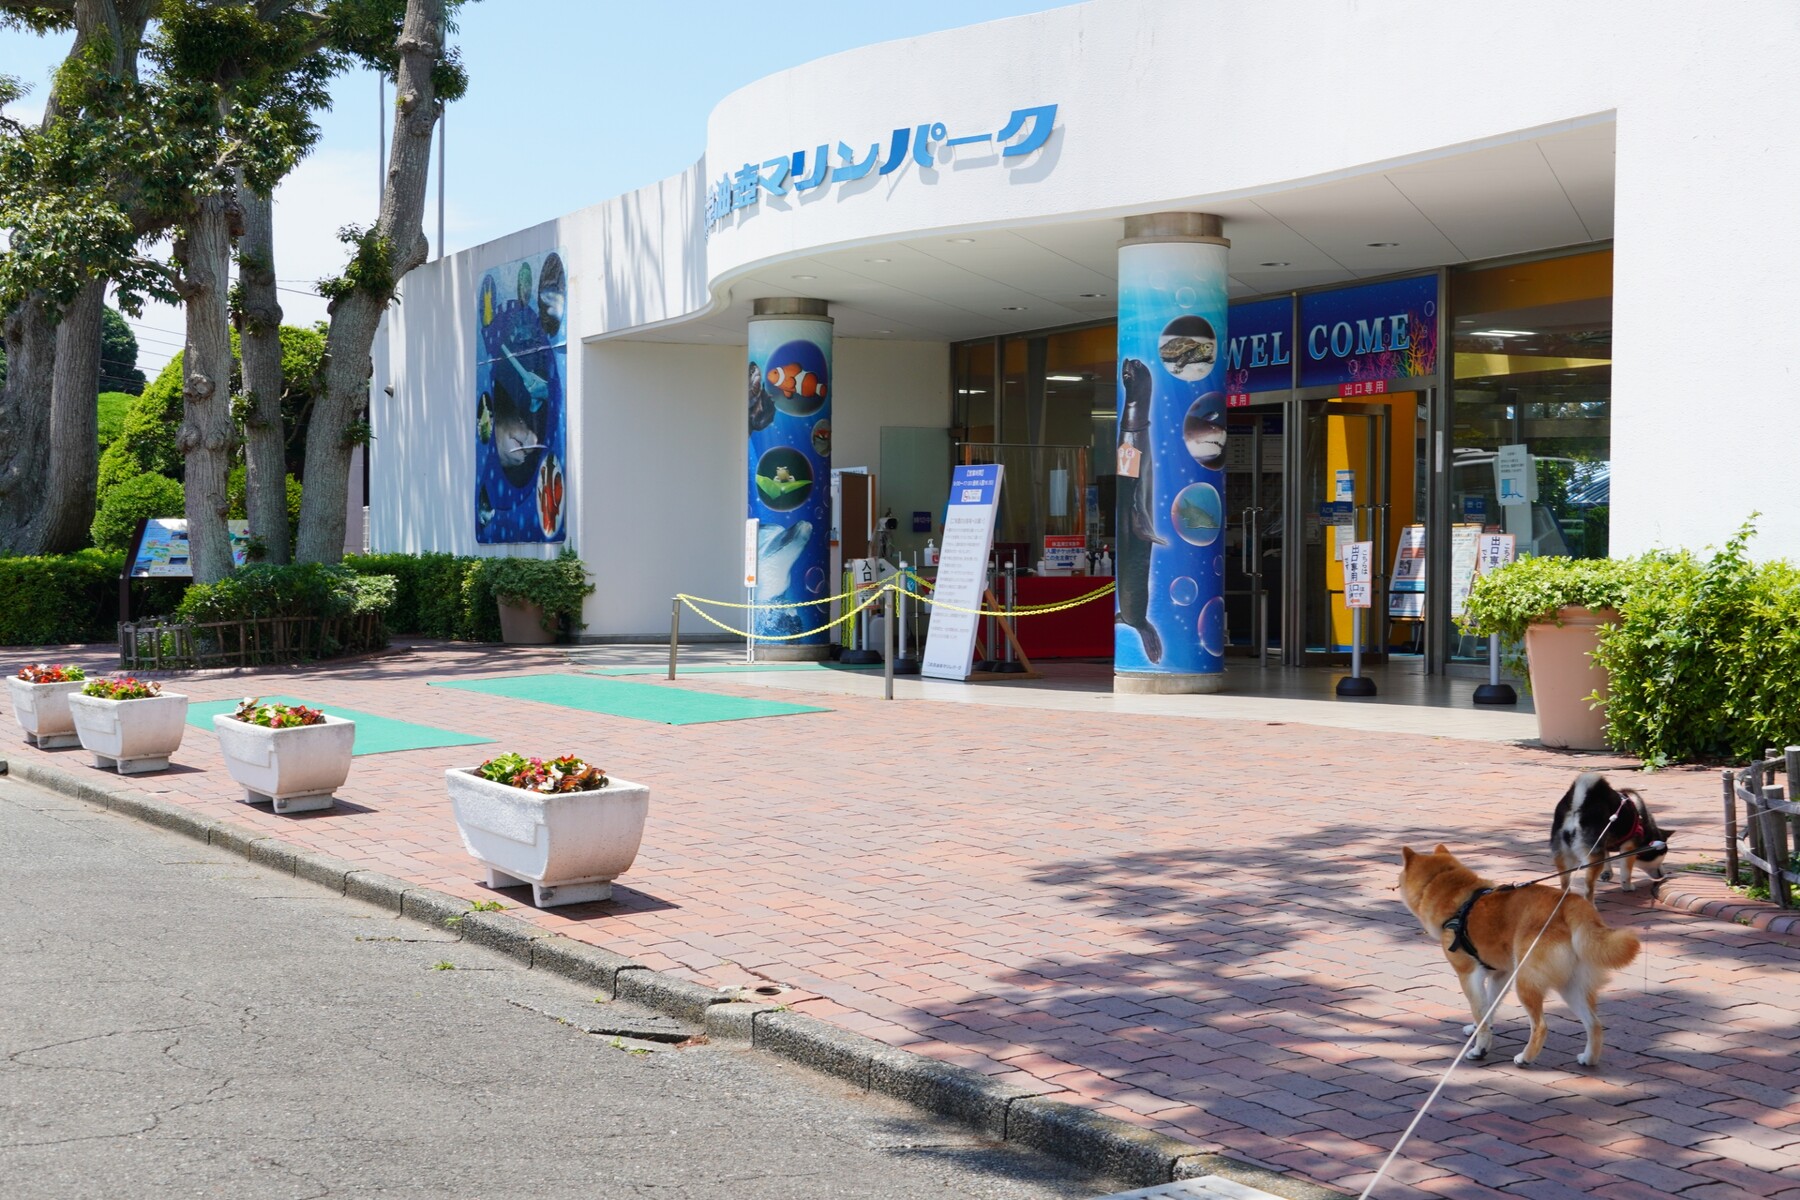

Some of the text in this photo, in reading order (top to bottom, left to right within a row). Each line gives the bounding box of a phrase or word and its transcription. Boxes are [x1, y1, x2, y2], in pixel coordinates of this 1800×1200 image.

[1226, 313, 1411, 371] WEL COME
[1343, 380, 1385, 397] 出口専用
[1489, 536, 1501, 569] 出口専
[861, 560, 872, 582] 入口
